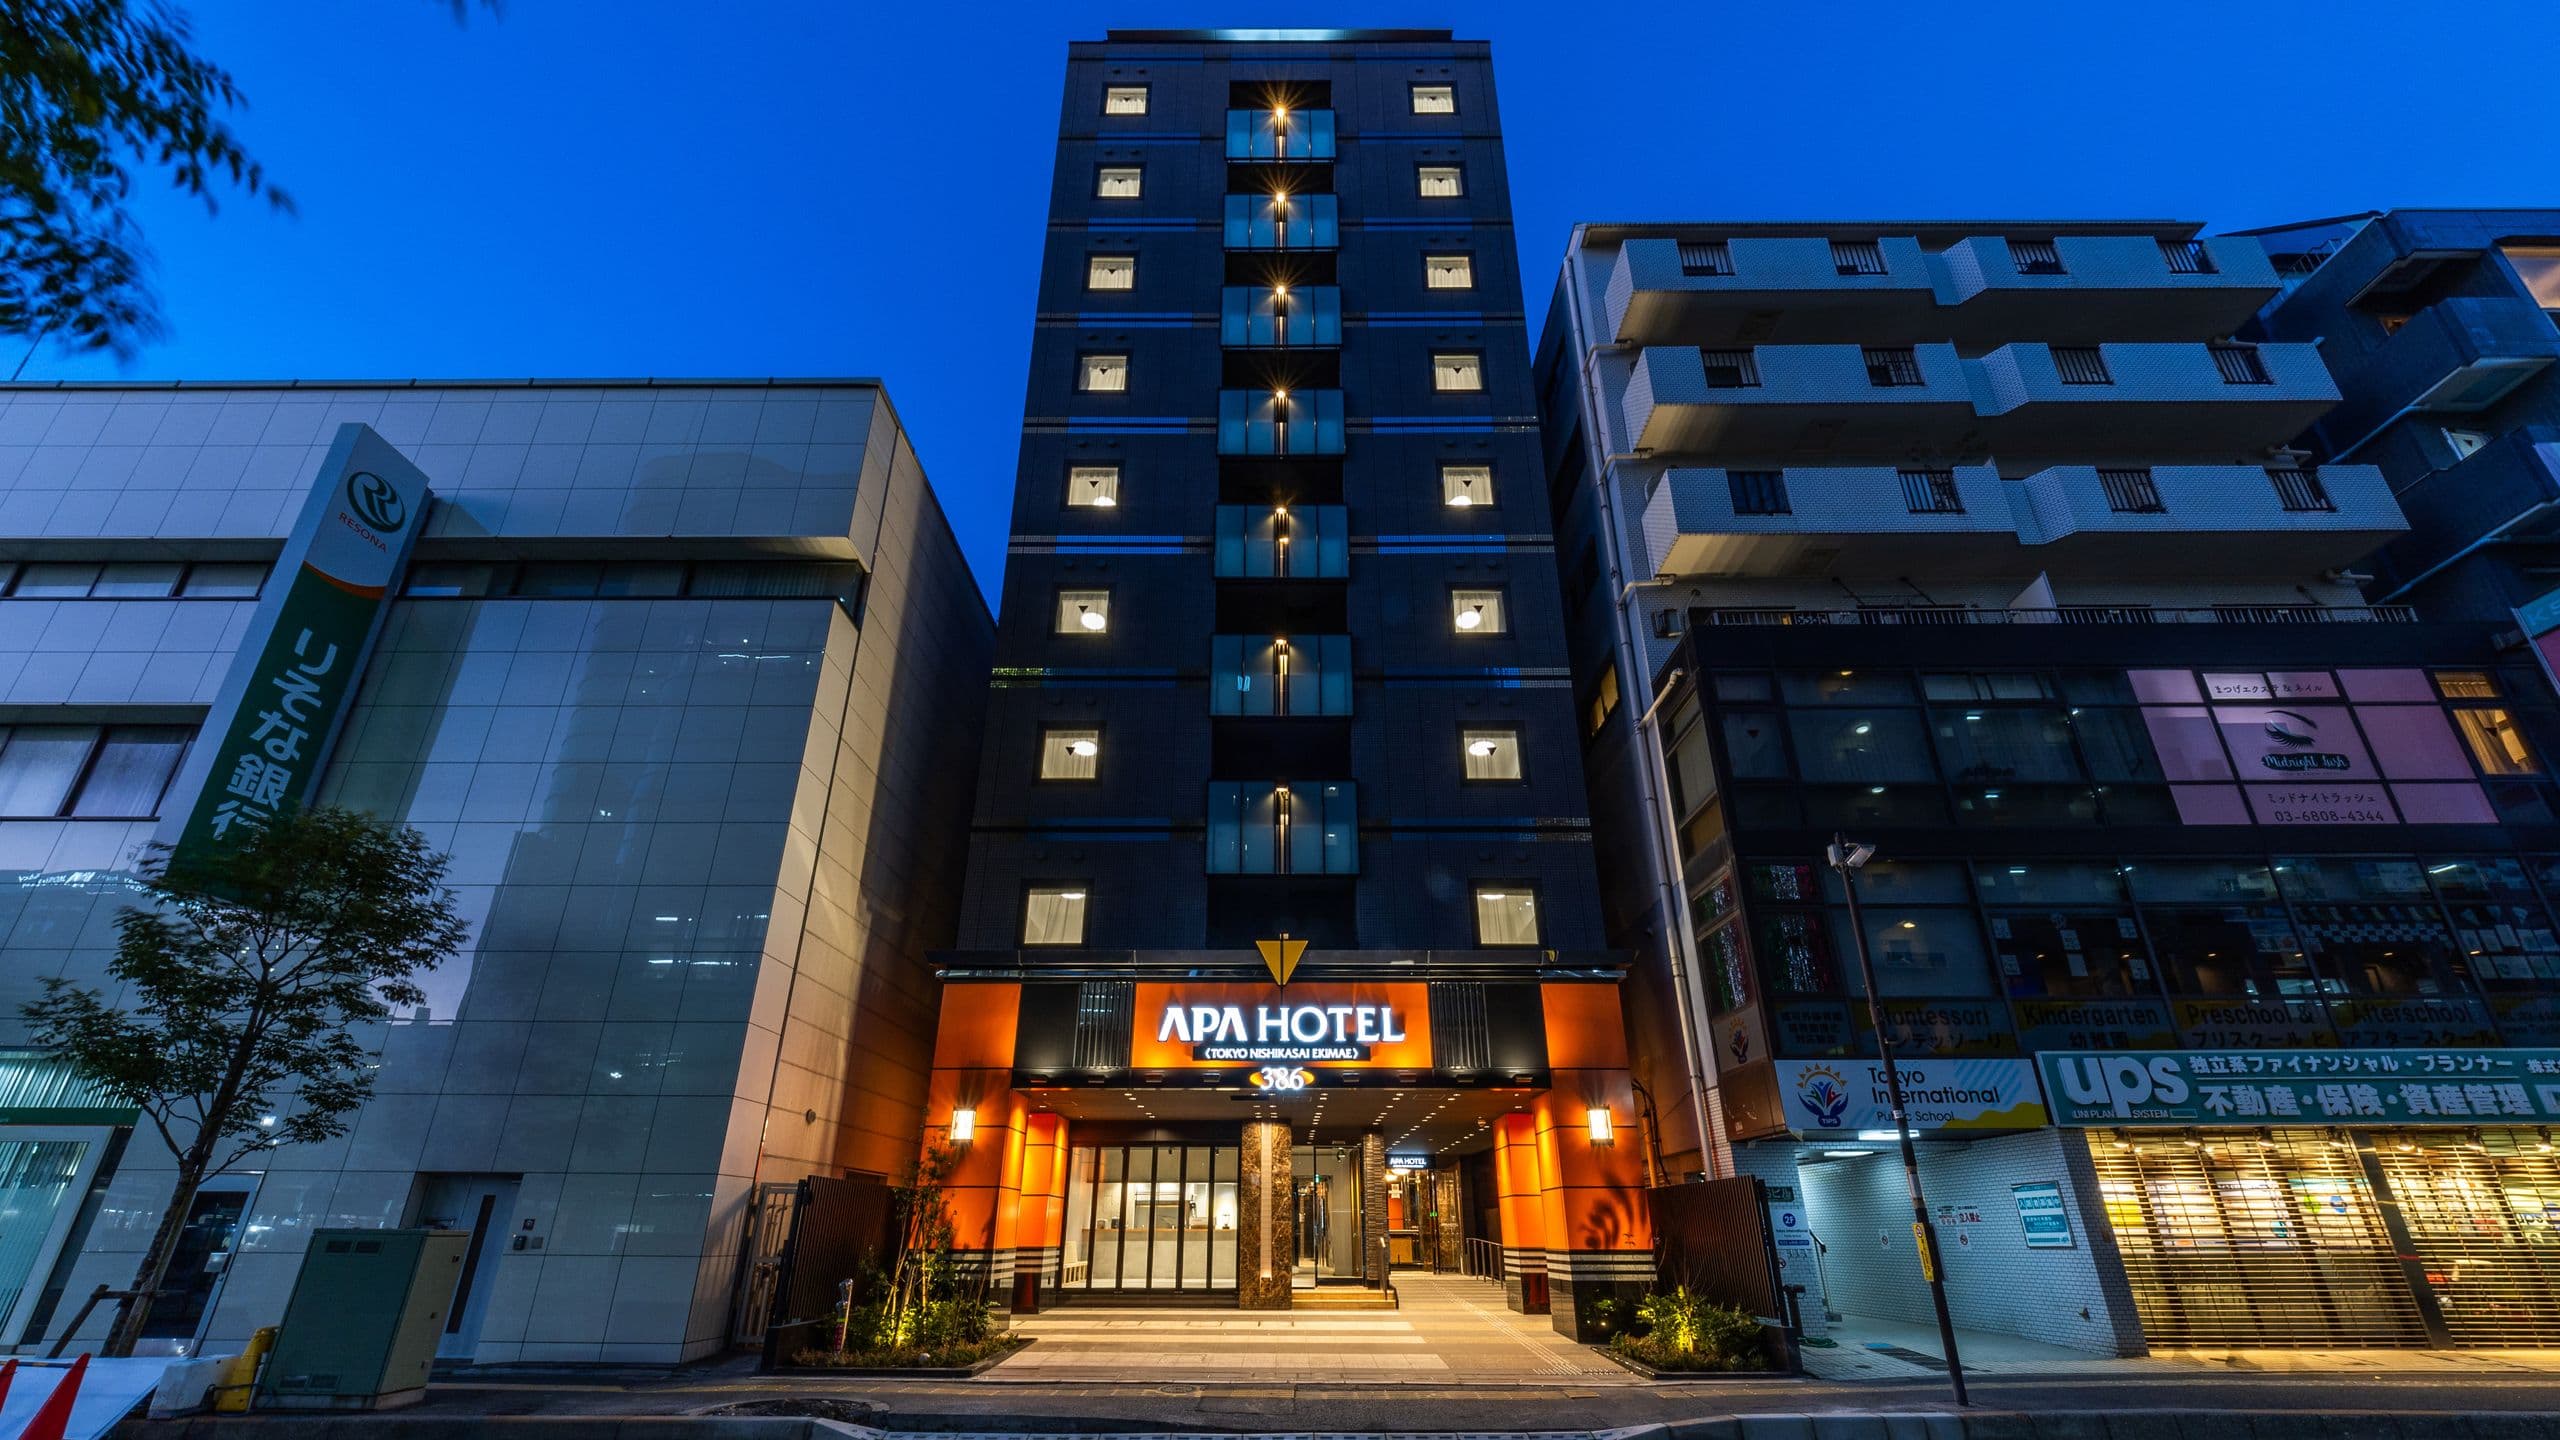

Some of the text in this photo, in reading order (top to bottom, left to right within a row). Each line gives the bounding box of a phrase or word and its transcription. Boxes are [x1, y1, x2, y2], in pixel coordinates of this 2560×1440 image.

[338, 511, 388, 553] RESONA
[2267, 792, 2377, 803] ミッドナイトラッシュ
[2274, 810, 2385, 822] 03-6808-4344
[2024, 1004, 2160, 1028] Kindergarten
[2185, 1004, 2314, 1025] Preschool &
[2351, 1003, 2474, 1024] Afterschool
[1157, 1006, 1406, 1043] APA HOTEL
[1250, 1048, 1310, 1059] NISHIKASAI
[2188, 1054, 2513, 1074] 独立系ファイナンシャル・プランナー
[1260, 1067, 1305, 1091] 386
[2057, 1055, 2190, 1118] ups
[1871, 1086, 2001, 1105] Inernational
[2198, 1083, 2536, 1117] 不動産・保険・資産管理
[1916, 1110, 1955, 1121] School
[2132, 1110, 2169, 1119] SYSTEM
[1404, 1157, 1427, 1165] HOTEL
